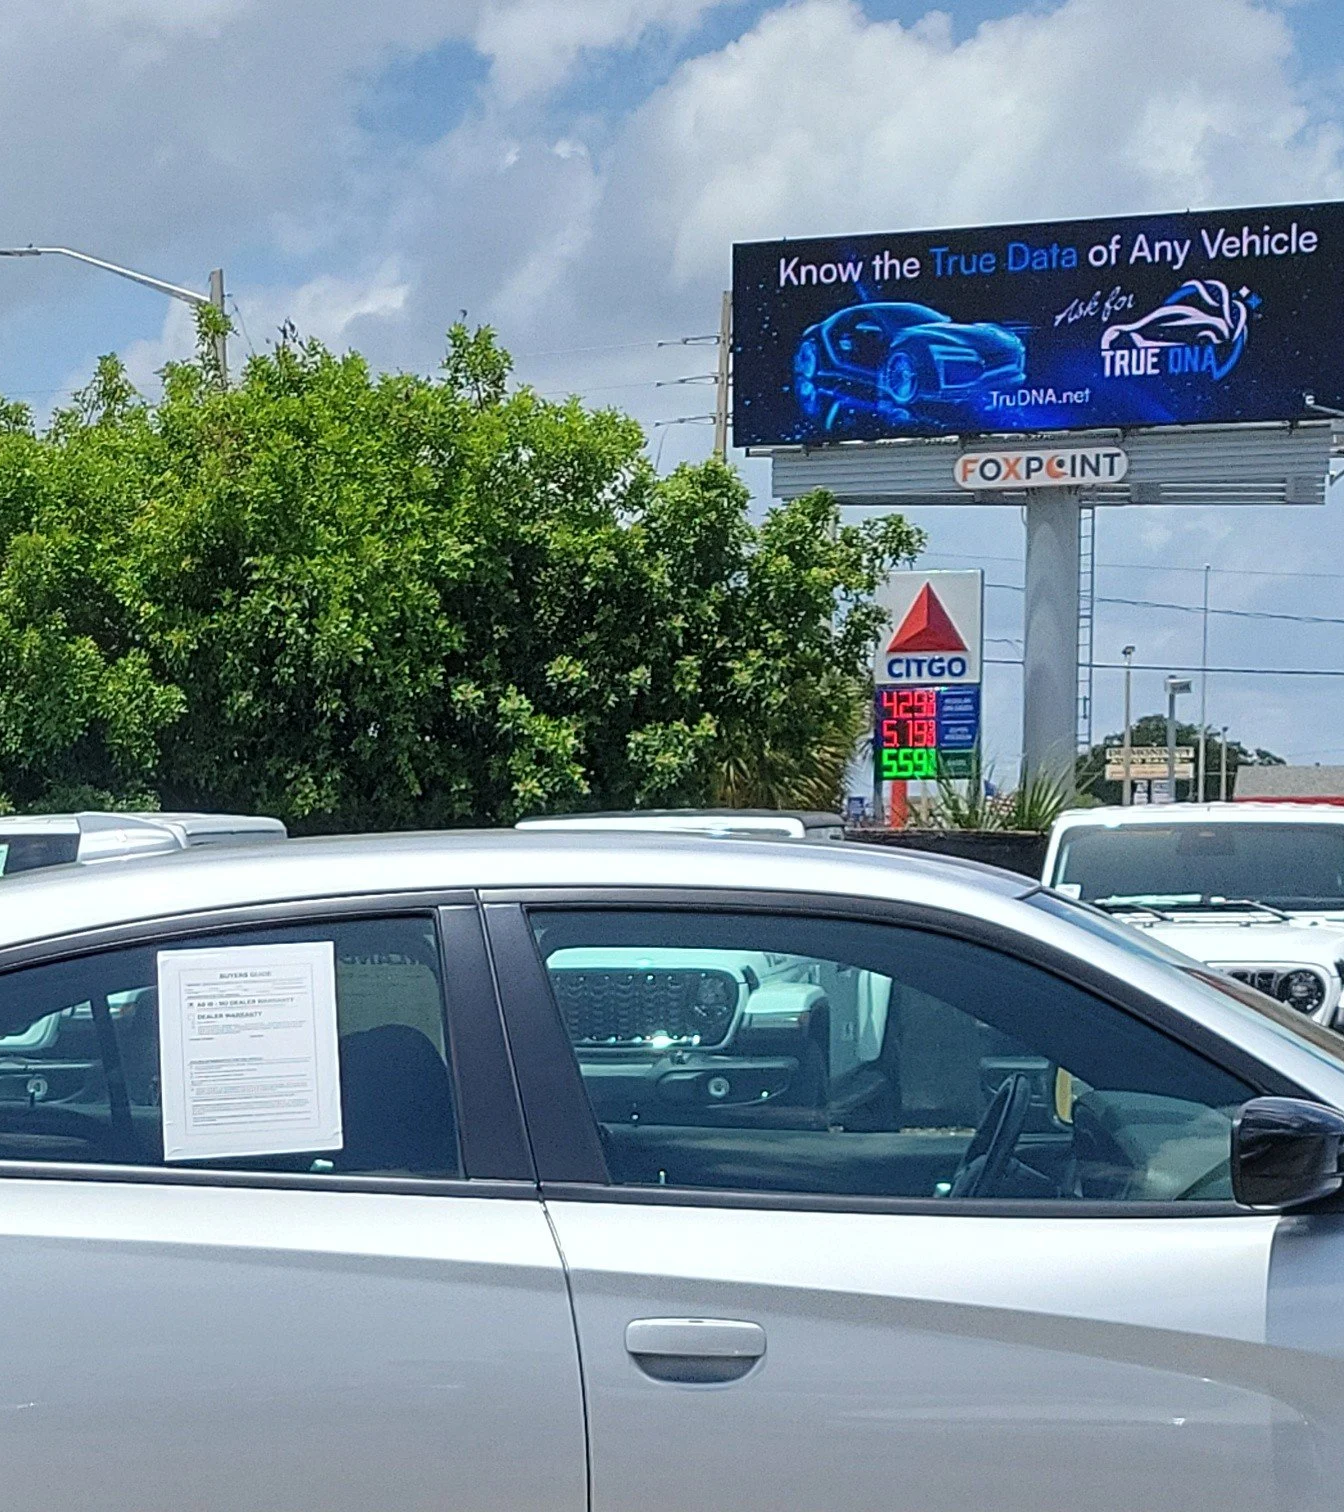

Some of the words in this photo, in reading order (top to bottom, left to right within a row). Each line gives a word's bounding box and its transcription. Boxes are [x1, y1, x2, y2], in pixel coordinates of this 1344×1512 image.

[779, 256, 863, 287] Know
[872, 250, 921, 281] the
[929, 246, 996, 277] True
[1007, 242, 1078, 272] Data
[1088, 234, 1121, 267] of
[1129, 233, 1192, 270] Any
[1201, 222, 1319, 260] Vehicle
[1054, 290, 1102, 327] Ask
[1101, 286, 1135, 322] for
[1101, 348, 1161, 378] TRUE
[1168, 346, 1219, 376] DNA
[989, 387, 1091, 407] TruDNA.net
[961, 452, 1122, 482] FOXPOINT
[887, 656, 967, 678] CITGO
